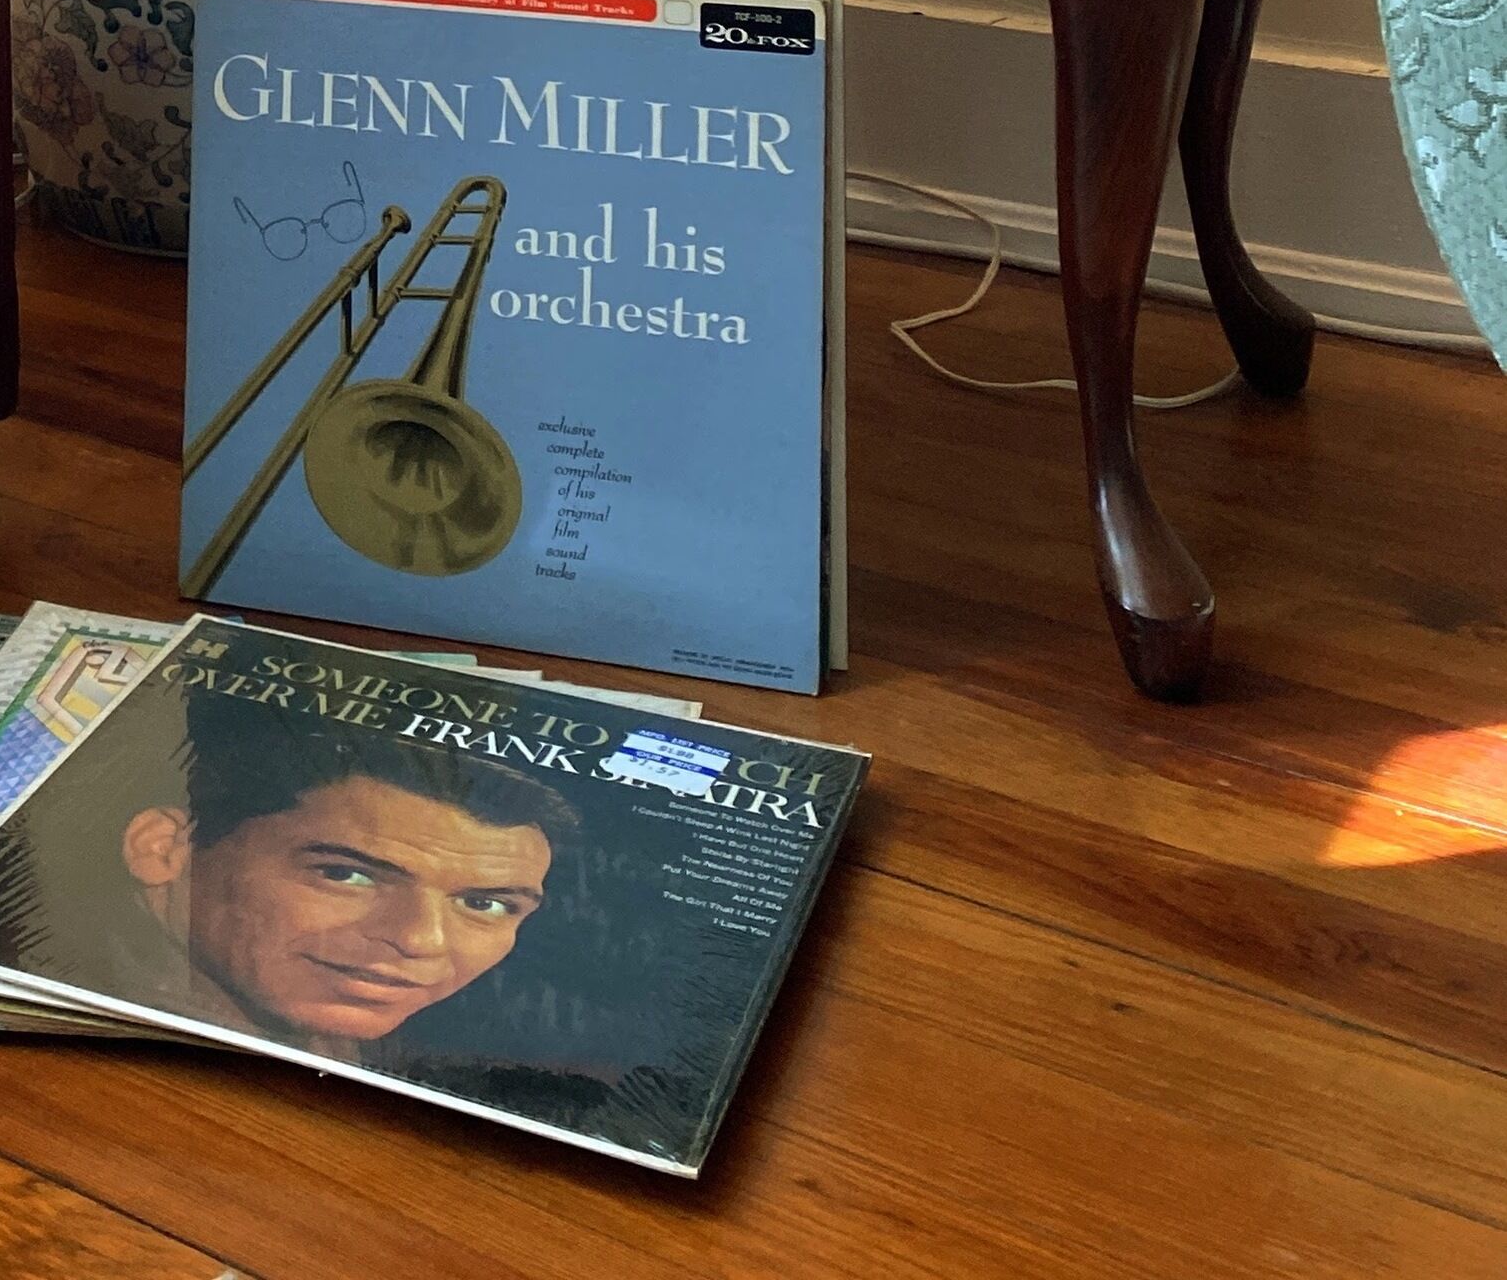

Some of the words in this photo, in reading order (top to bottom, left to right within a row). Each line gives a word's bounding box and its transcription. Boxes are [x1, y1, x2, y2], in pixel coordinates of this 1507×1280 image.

[553, 0, 588, 12] Sound
[594, 2, 634, 16] Tracks
[213, 51, 474, 141] GLENN
[489, 75, 795, 175] MILLER
[515, 202, 617, 264] and
[644, 207, 726, 275] his
[490, 266, 751, 344] orchestra
[538, 415, 596, 438] exclusive
[546, 440, 605, 460] complete
[554, 462, 633, 484] compilation
[558, 479, 575, 501] of
[575, 481, 596, 500] his
[557, 505, 612, 523] original
[552, 519, 580, 540] film
[545, 543, 588, 561] sound
[535, 562, 577, 580] tracks
[252, 655, 518, 729] SOMEONE
[532, 712, 610, 747] TO
[161, 663, 296, 708] OVER
[301, 692, 393, 730] ME
[399, 713, 585, 775] FRANK
[697, 744, 732, 757] PRICE
[668, 759, 702, 772] PRICE
[638, 806, 682, 822] Couldn't
[684, 817, 715, 830] Sleep
[726, 825, 752, 838] Wink
[754, 832, 778, 845] Last
[779, 838, 810, 851] Night
[668, 801, 718, 818] Someone
[721, 812, 734, 821] To
[735, 816, 769, 829] Watch
[770, 824, 795, 835] Over
[798, 830, 815, 840] Me
[699, 834, 726, 845] Have
[728, 840, 747, 850] But
[749, 845, 772, 856] One
[773, 850, 805, 864] Heart
[681, 854, 701, 865] The
[703, 860, 755, 878] Nearness
[757, 873, 771, 882] Of
[773, 876, 794, 887] You
[701, 847, 733, 860] Stella
[735, 854, 750, 864] By
[751, 857, 799, 875] Starlight
[662, 863, 682, 874] Put
[685, 869, 711, 881] Your
[711, 875, 756, 892] Dreams
[758, 887, 789, 900] Away
[663, 891, 684, 902] The
[685, 897, 707, 908] Girl
[709, 902, 735, 914] That
[744, 911, 778, 925] Marry
[732, 894, 748, 903] All
[749, 897, 763, 907] Of
[765, 901, 783, 912] Me
[720, 919, 747, 932] Love
[749, 926, 771, 938] You
